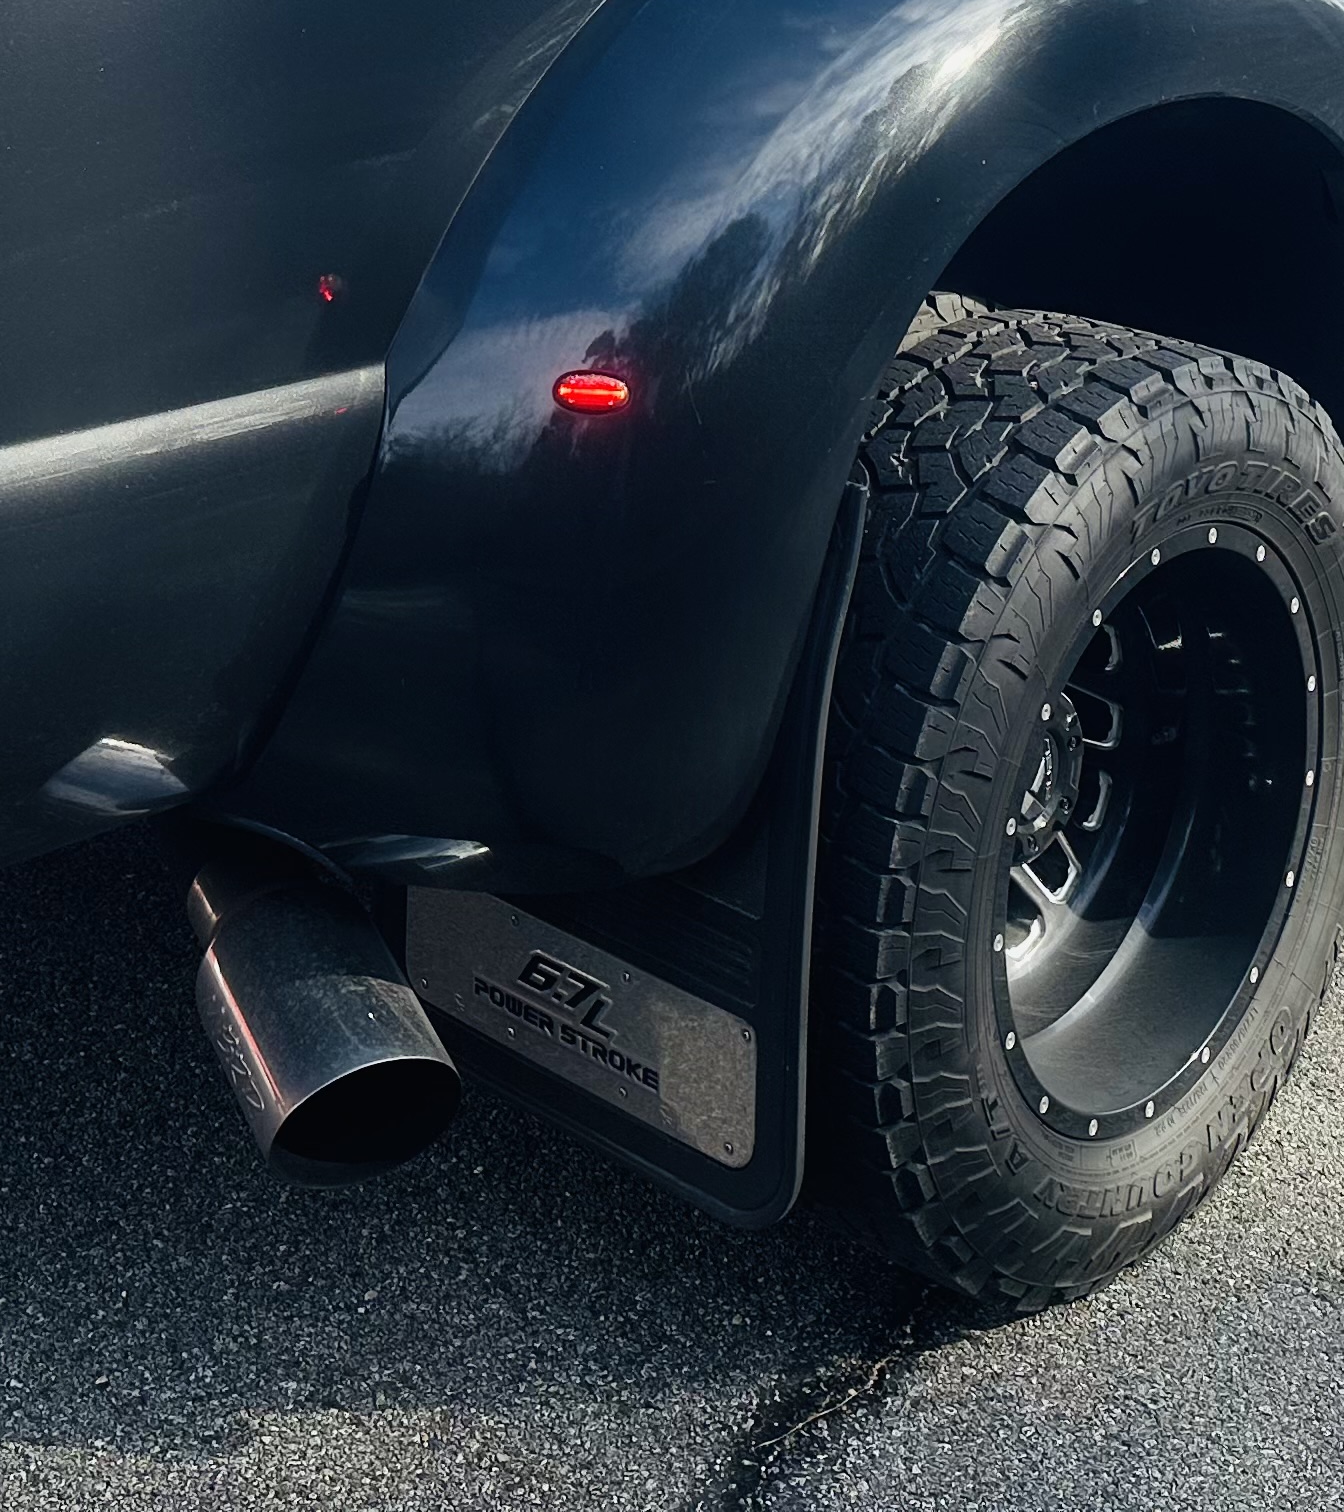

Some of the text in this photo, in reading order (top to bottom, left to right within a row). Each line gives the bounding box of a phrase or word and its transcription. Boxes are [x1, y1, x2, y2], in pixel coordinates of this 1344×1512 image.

[1239, 459, 1339, 546] TIRES
[473, 975, 659, 1091] POWER STROKE
[516, 949, 618, 1039] 6.7L
